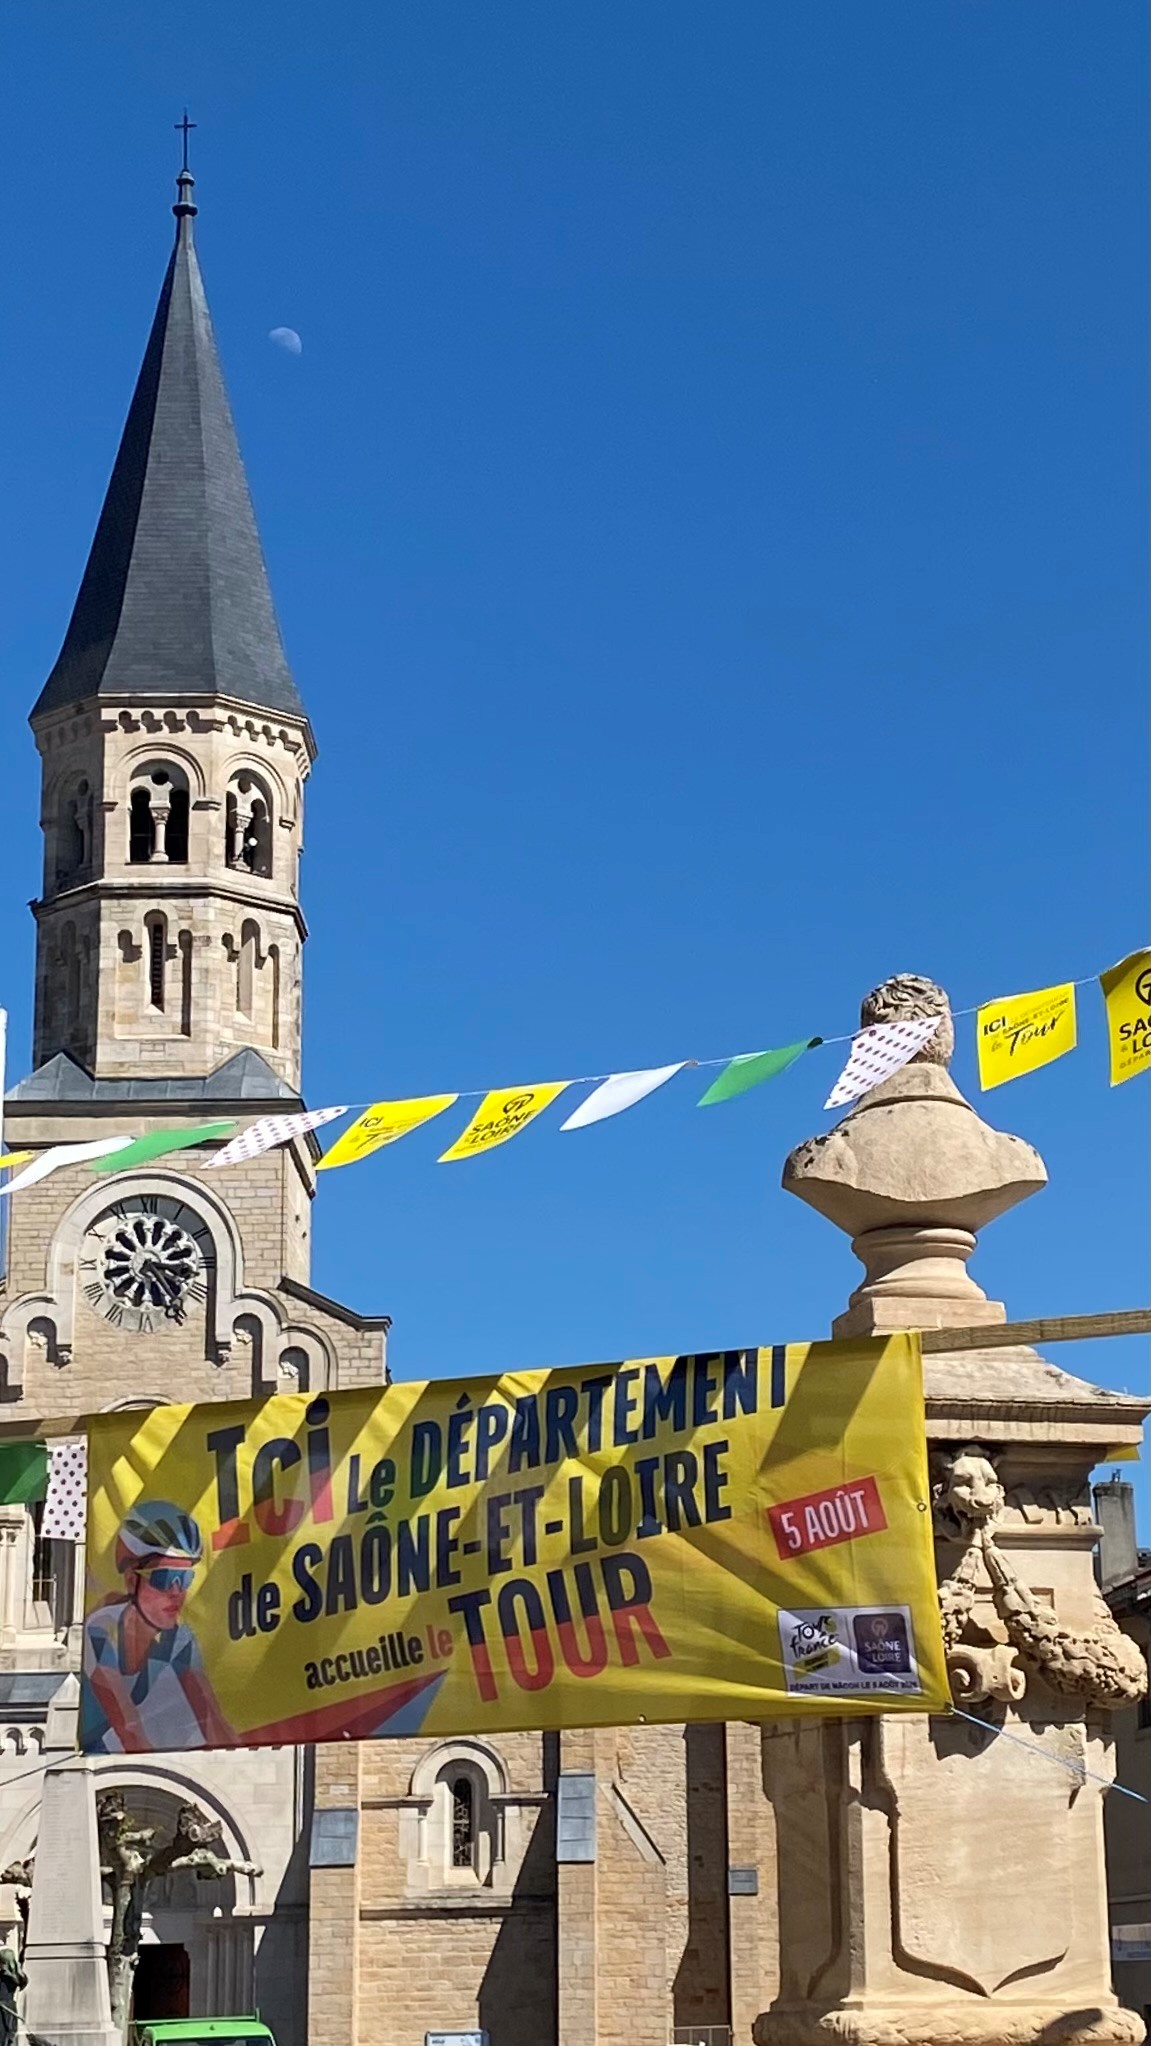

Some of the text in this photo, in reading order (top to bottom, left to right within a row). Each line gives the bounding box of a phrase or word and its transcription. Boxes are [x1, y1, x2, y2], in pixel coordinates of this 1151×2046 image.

[983, 1016, 1006, 1036] ICI
[1004, 1009, 1066, 1056] Tour
[359, 1116, 384, 1129] ICI
[228, 1440, 732, 1641] de SAÔNE-ET-LOIRE
[780, 1490, 869, 1549] 5 AOÛT
[304, 1551, 673, 1703] accueille le TOUR
